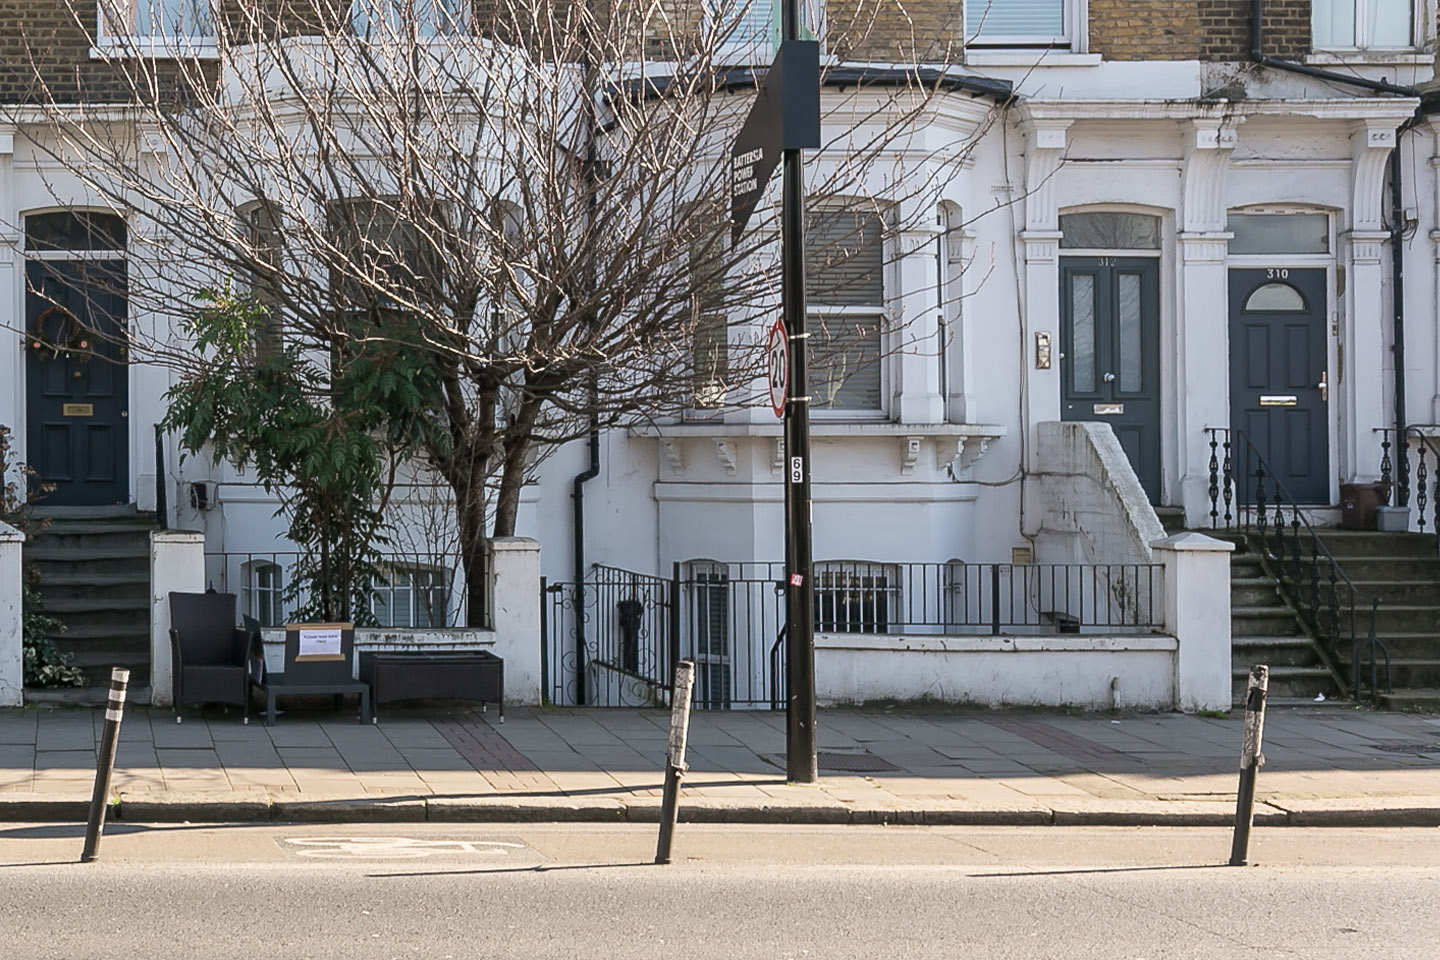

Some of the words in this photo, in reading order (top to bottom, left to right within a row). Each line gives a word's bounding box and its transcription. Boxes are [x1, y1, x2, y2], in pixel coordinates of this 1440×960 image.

[733, 178, 758, 197] STATION
[1266, 268, 1289, 279] 310
[771, 349, 786, 389] 20
